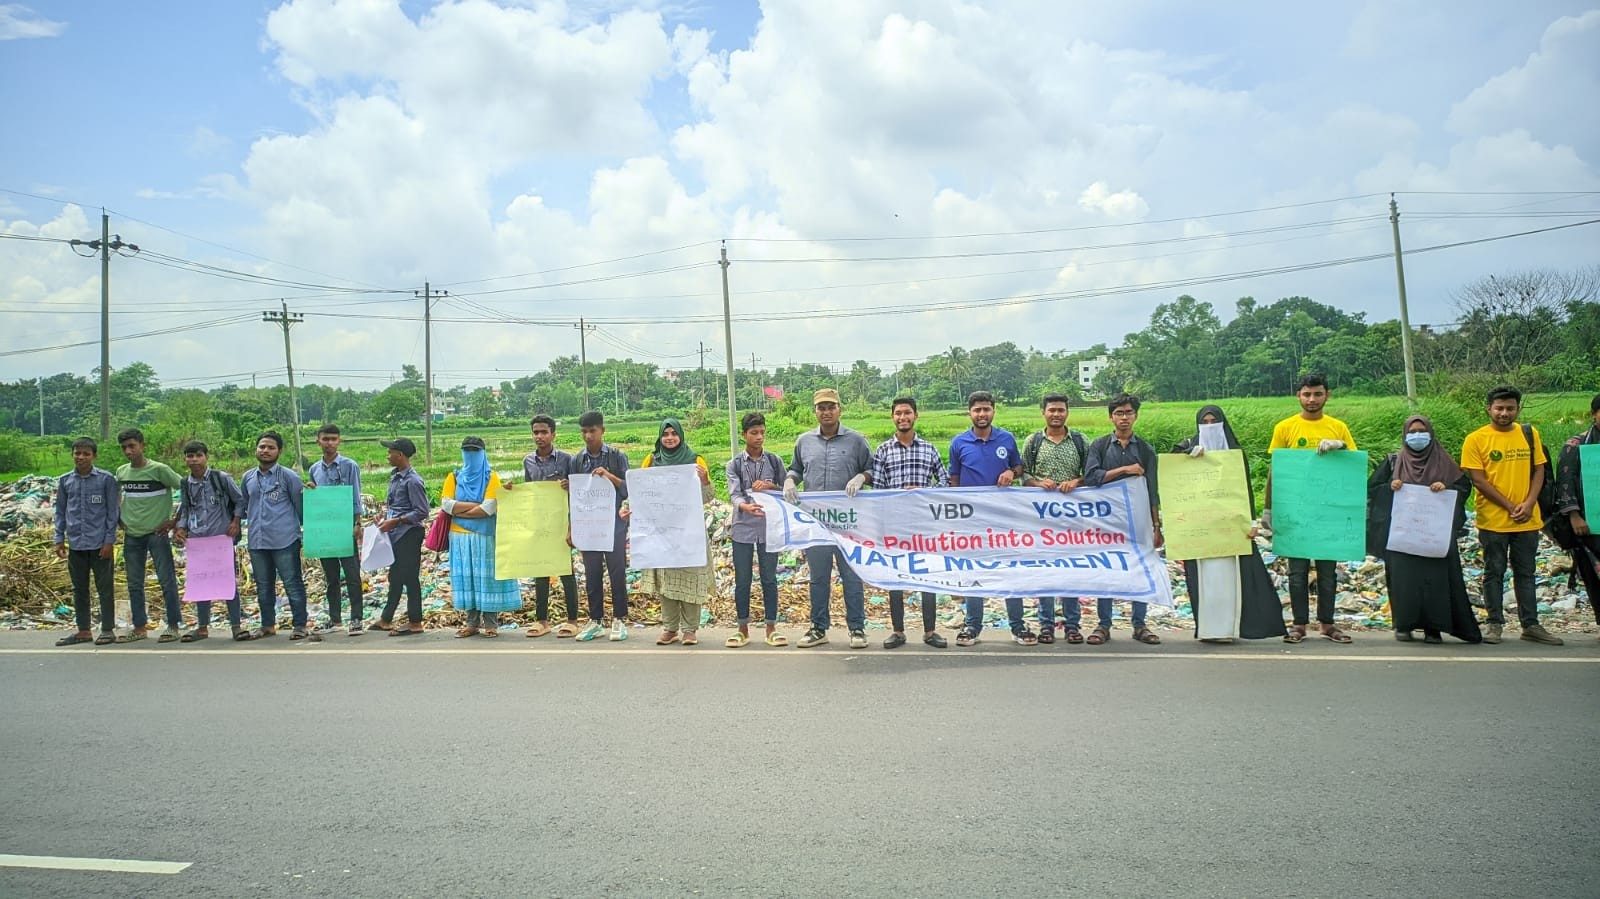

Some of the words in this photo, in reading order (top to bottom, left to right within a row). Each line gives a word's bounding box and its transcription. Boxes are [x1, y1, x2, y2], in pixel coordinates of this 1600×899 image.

[811, 508, 858, 524] thNet
[929, 503, 974, 521] VBD
[1032, 500, 1112, 519] YCSBD
[884, 530, 983, 553] Pollution
[986, 528, 1034, 549] into
[1040, 527, 1125, 546] Solution
